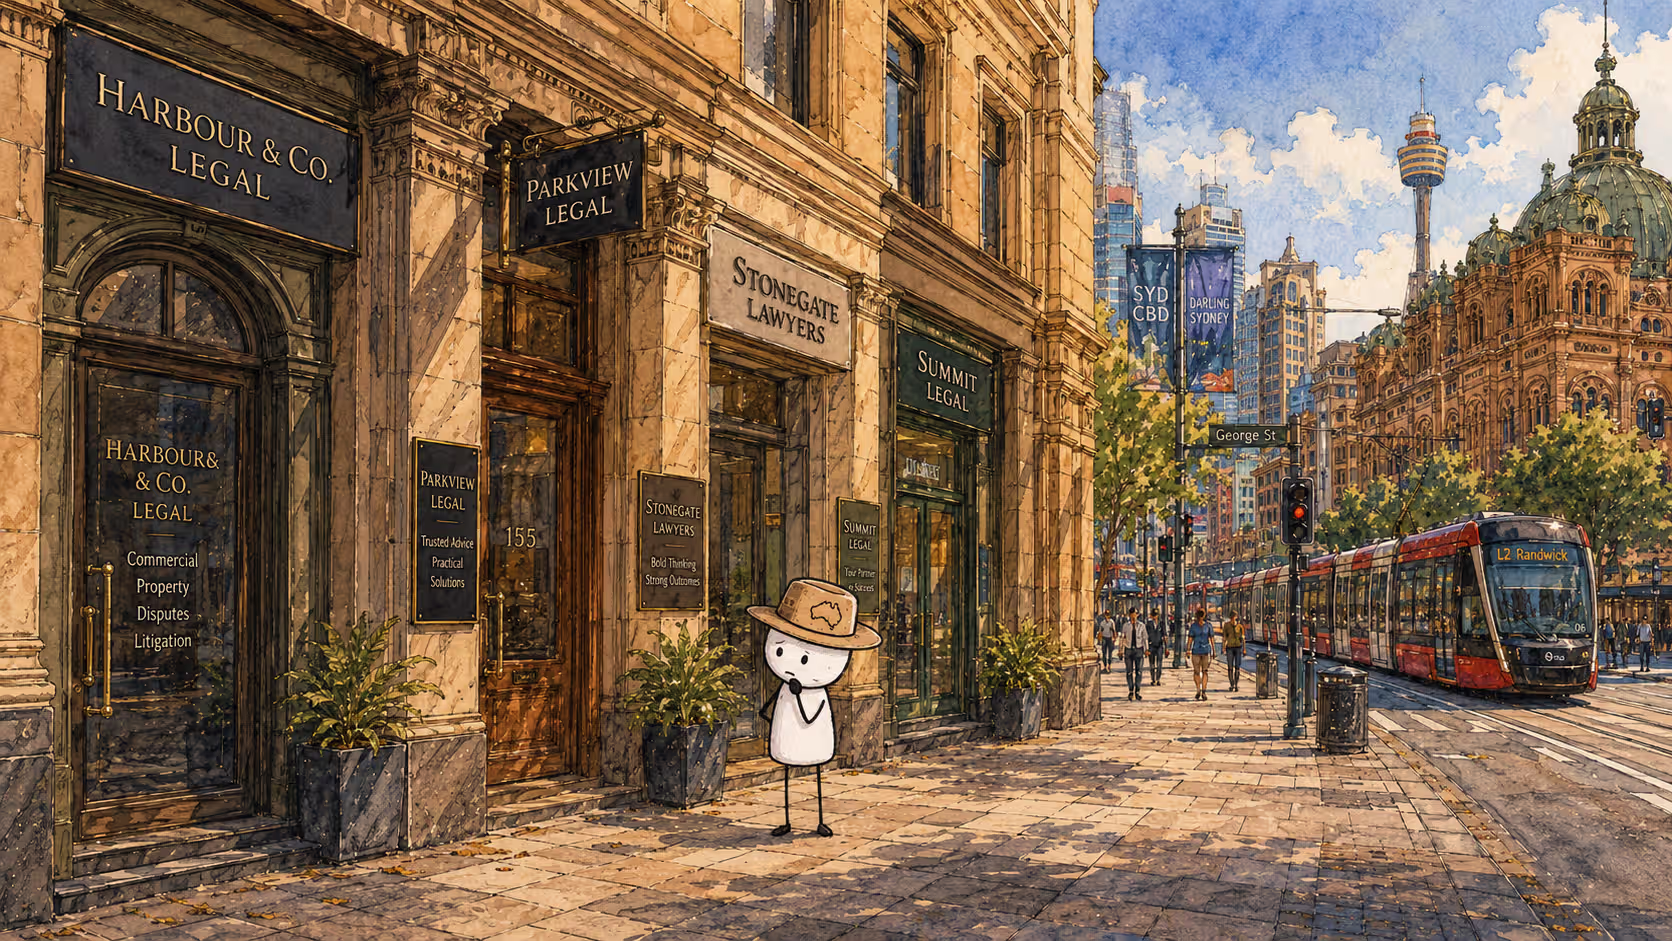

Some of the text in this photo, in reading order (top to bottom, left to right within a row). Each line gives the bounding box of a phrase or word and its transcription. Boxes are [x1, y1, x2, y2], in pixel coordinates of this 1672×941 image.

[97, 72, 254, 157] HARBOUR
[262, 138, 282, 167] &
[170, 145, 271, 201] LEGAL
[526, 161, 633, 203] PARKVIEW
[545, 196, 613, 226] LEGAL
[733, 256, 839, 325] STONEGATE
[1133, 286, 1169, 303] SYD
[1190, 297, 1230, 309] DARLING
[746, 298, 825, 344] LAWYERS
[1133, 305, 1169, 322] CBD
[1190, 312, 1230, 325] SYDNEY
[918, 350, 978, 393] SUMMIT
[926, 382, 969, 413] LEGAL
[1216, 429, 1276, 444] George St
[135, 471, 150, 491] &
[421, 470, 476, 491] PARKVIEW
[431, 495, 465, 511] LEGAL
[645, 499, 701, 519] STONEGATE
[133, 502, 193, 522] LEGAL
[653, 521, 695, 537] LAWYERS
[844, 520, 877, 536] SUMMIT
[421, 534, 474, 549] Trusted Advice
[506, 526, 536, 548] 155
[849, 539, 872, 551] LEGAL
[127, 551, 199, 568] Commercial
[432, 556, 464, 569] Practical
[651, 556, 667, 568] Bold
[1497, 548, 1569, 561] L2 Randwick
[137, 578, 190, 597] Property
[430, 576, 465, 588] Solutions
[645, 574, 668, 588] Strong
[137, 606, 190, 625] Disputes
[1574, 623, 1587, 632] 06
[134, 633, 192, 652] Litigation
